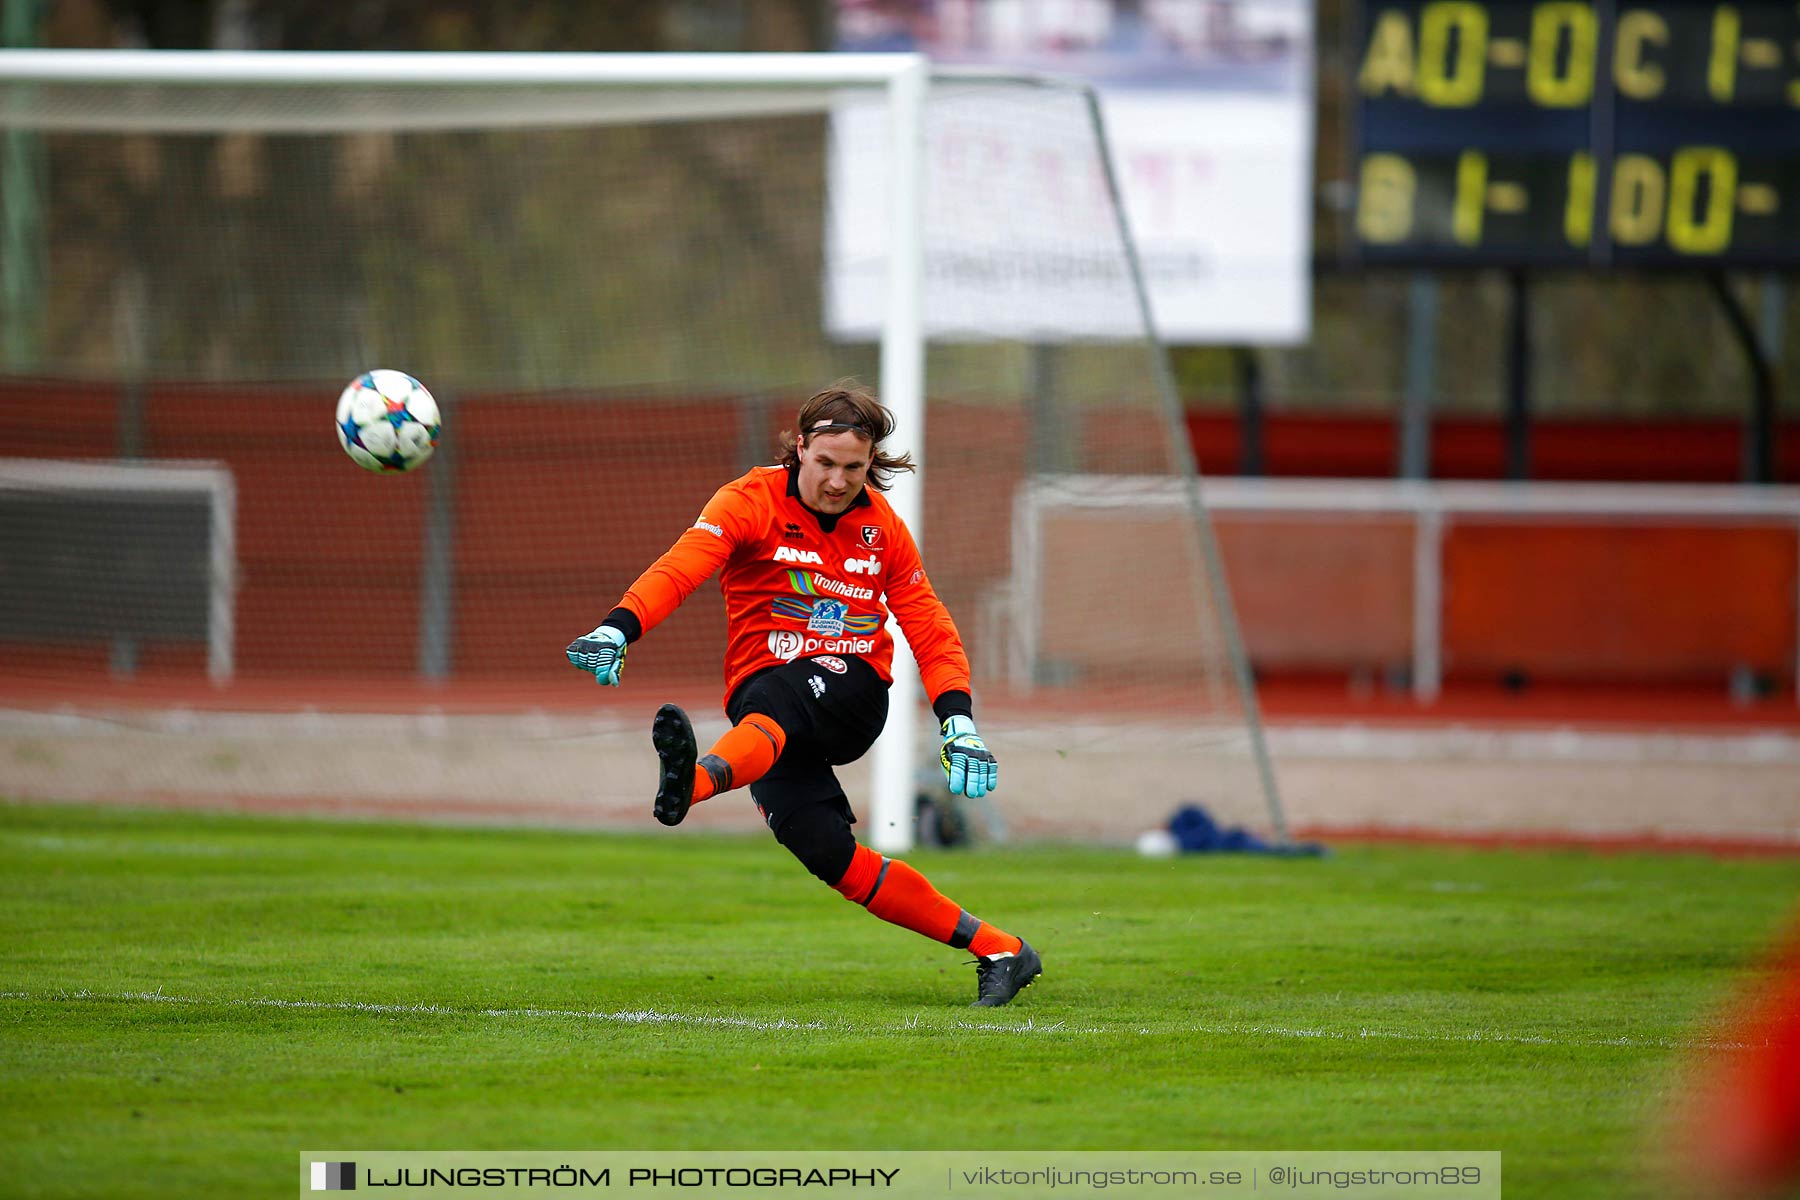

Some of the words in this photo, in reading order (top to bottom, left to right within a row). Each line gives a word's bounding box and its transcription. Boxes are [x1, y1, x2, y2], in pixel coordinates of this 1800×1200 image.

[1358, 8, 1417, 96] A
[1612, 9, 1669, 98] C
[773, 546, 824, 565] ANA
[805, 637, 875, 653] premier
